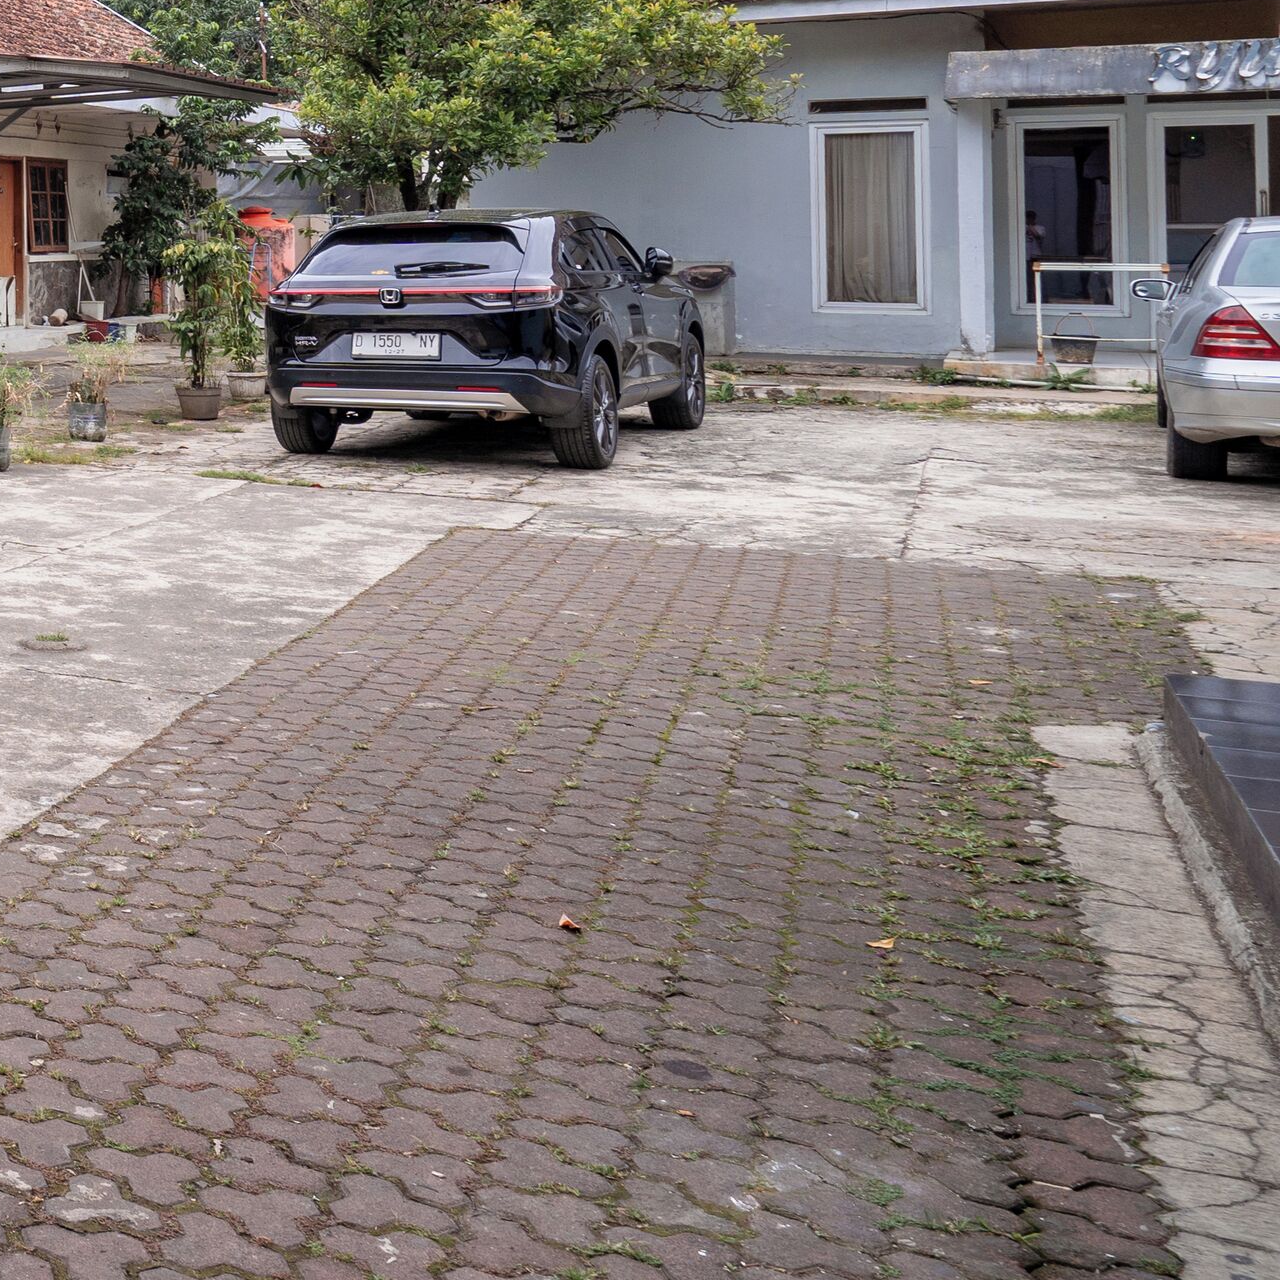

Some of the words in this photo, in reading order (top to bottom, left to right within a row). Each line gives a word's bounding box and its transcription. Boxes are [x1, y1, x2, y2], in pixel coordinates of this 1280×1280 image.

[355, 335, 363, 348] D
[372, 335, 402, 348] 1550
[420, 334, 436, 348] NY
